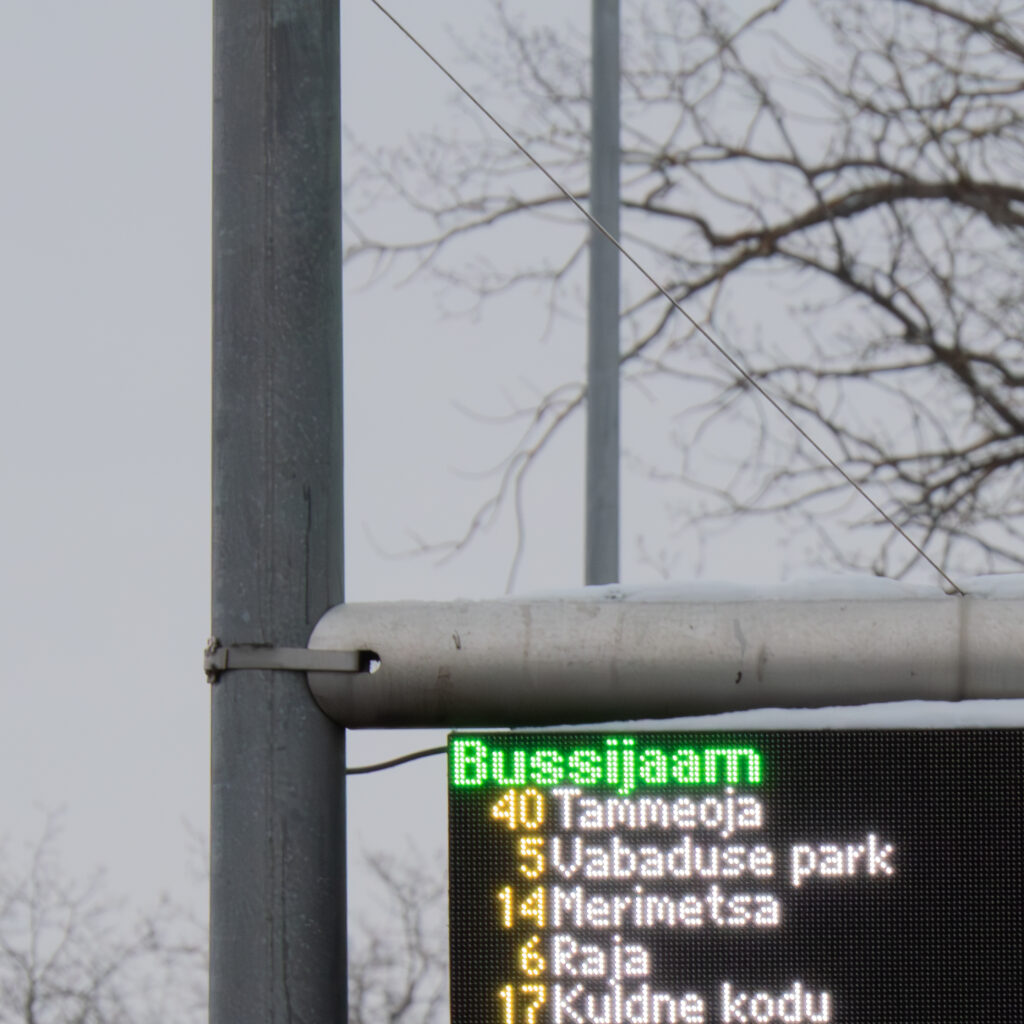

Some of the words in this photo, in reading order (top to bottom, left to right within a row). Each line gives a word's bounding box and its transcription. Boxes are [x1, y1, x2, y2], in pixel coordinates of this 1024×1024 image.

[453, 738, 763, 795] Bussijaam
[491, 788, 545, 829] 40
[552, 787, 763, 838] Tammeoja
[518, 836, 545, 878] 5
[552, 836, 775, 878] Vabaduse
[791, 834, 895, 887] park
[499, 886, 547, 928] 14
[552, 886, 781, 927] Merimetsa
[520, 935, 547, 977] 6
[552, 934, 651, 986] Raja
[499, 984, 547, 1024] 17
[553, 983, 705, 1024] Kuldne
[722, 982, 832, 1024] kodu
